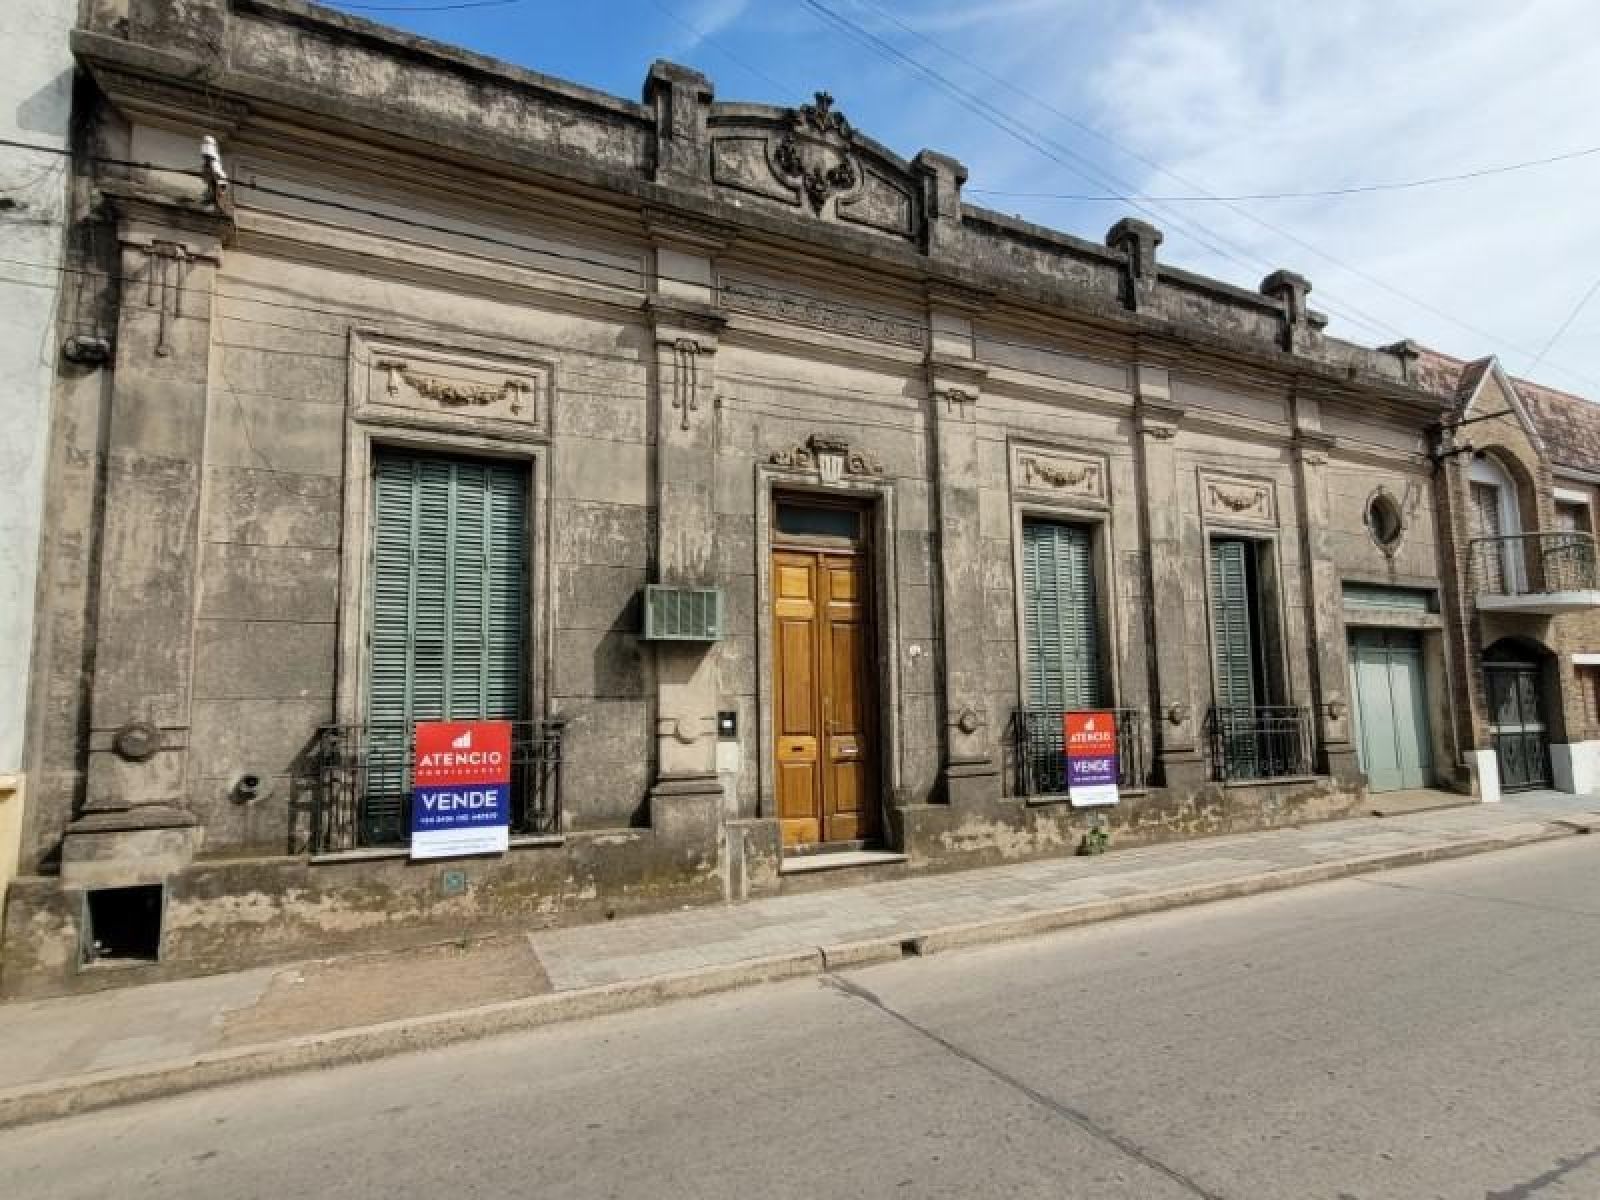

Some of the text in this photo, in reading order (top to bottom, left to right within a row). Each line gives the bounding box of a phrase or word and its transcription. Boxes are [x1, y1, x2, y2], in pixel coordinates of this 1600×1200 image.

[419, 752, 502, 767] ATENCIO
[1072, 759, 1111, 773] VENDE
[422, 789, 498, 810] VENDE
